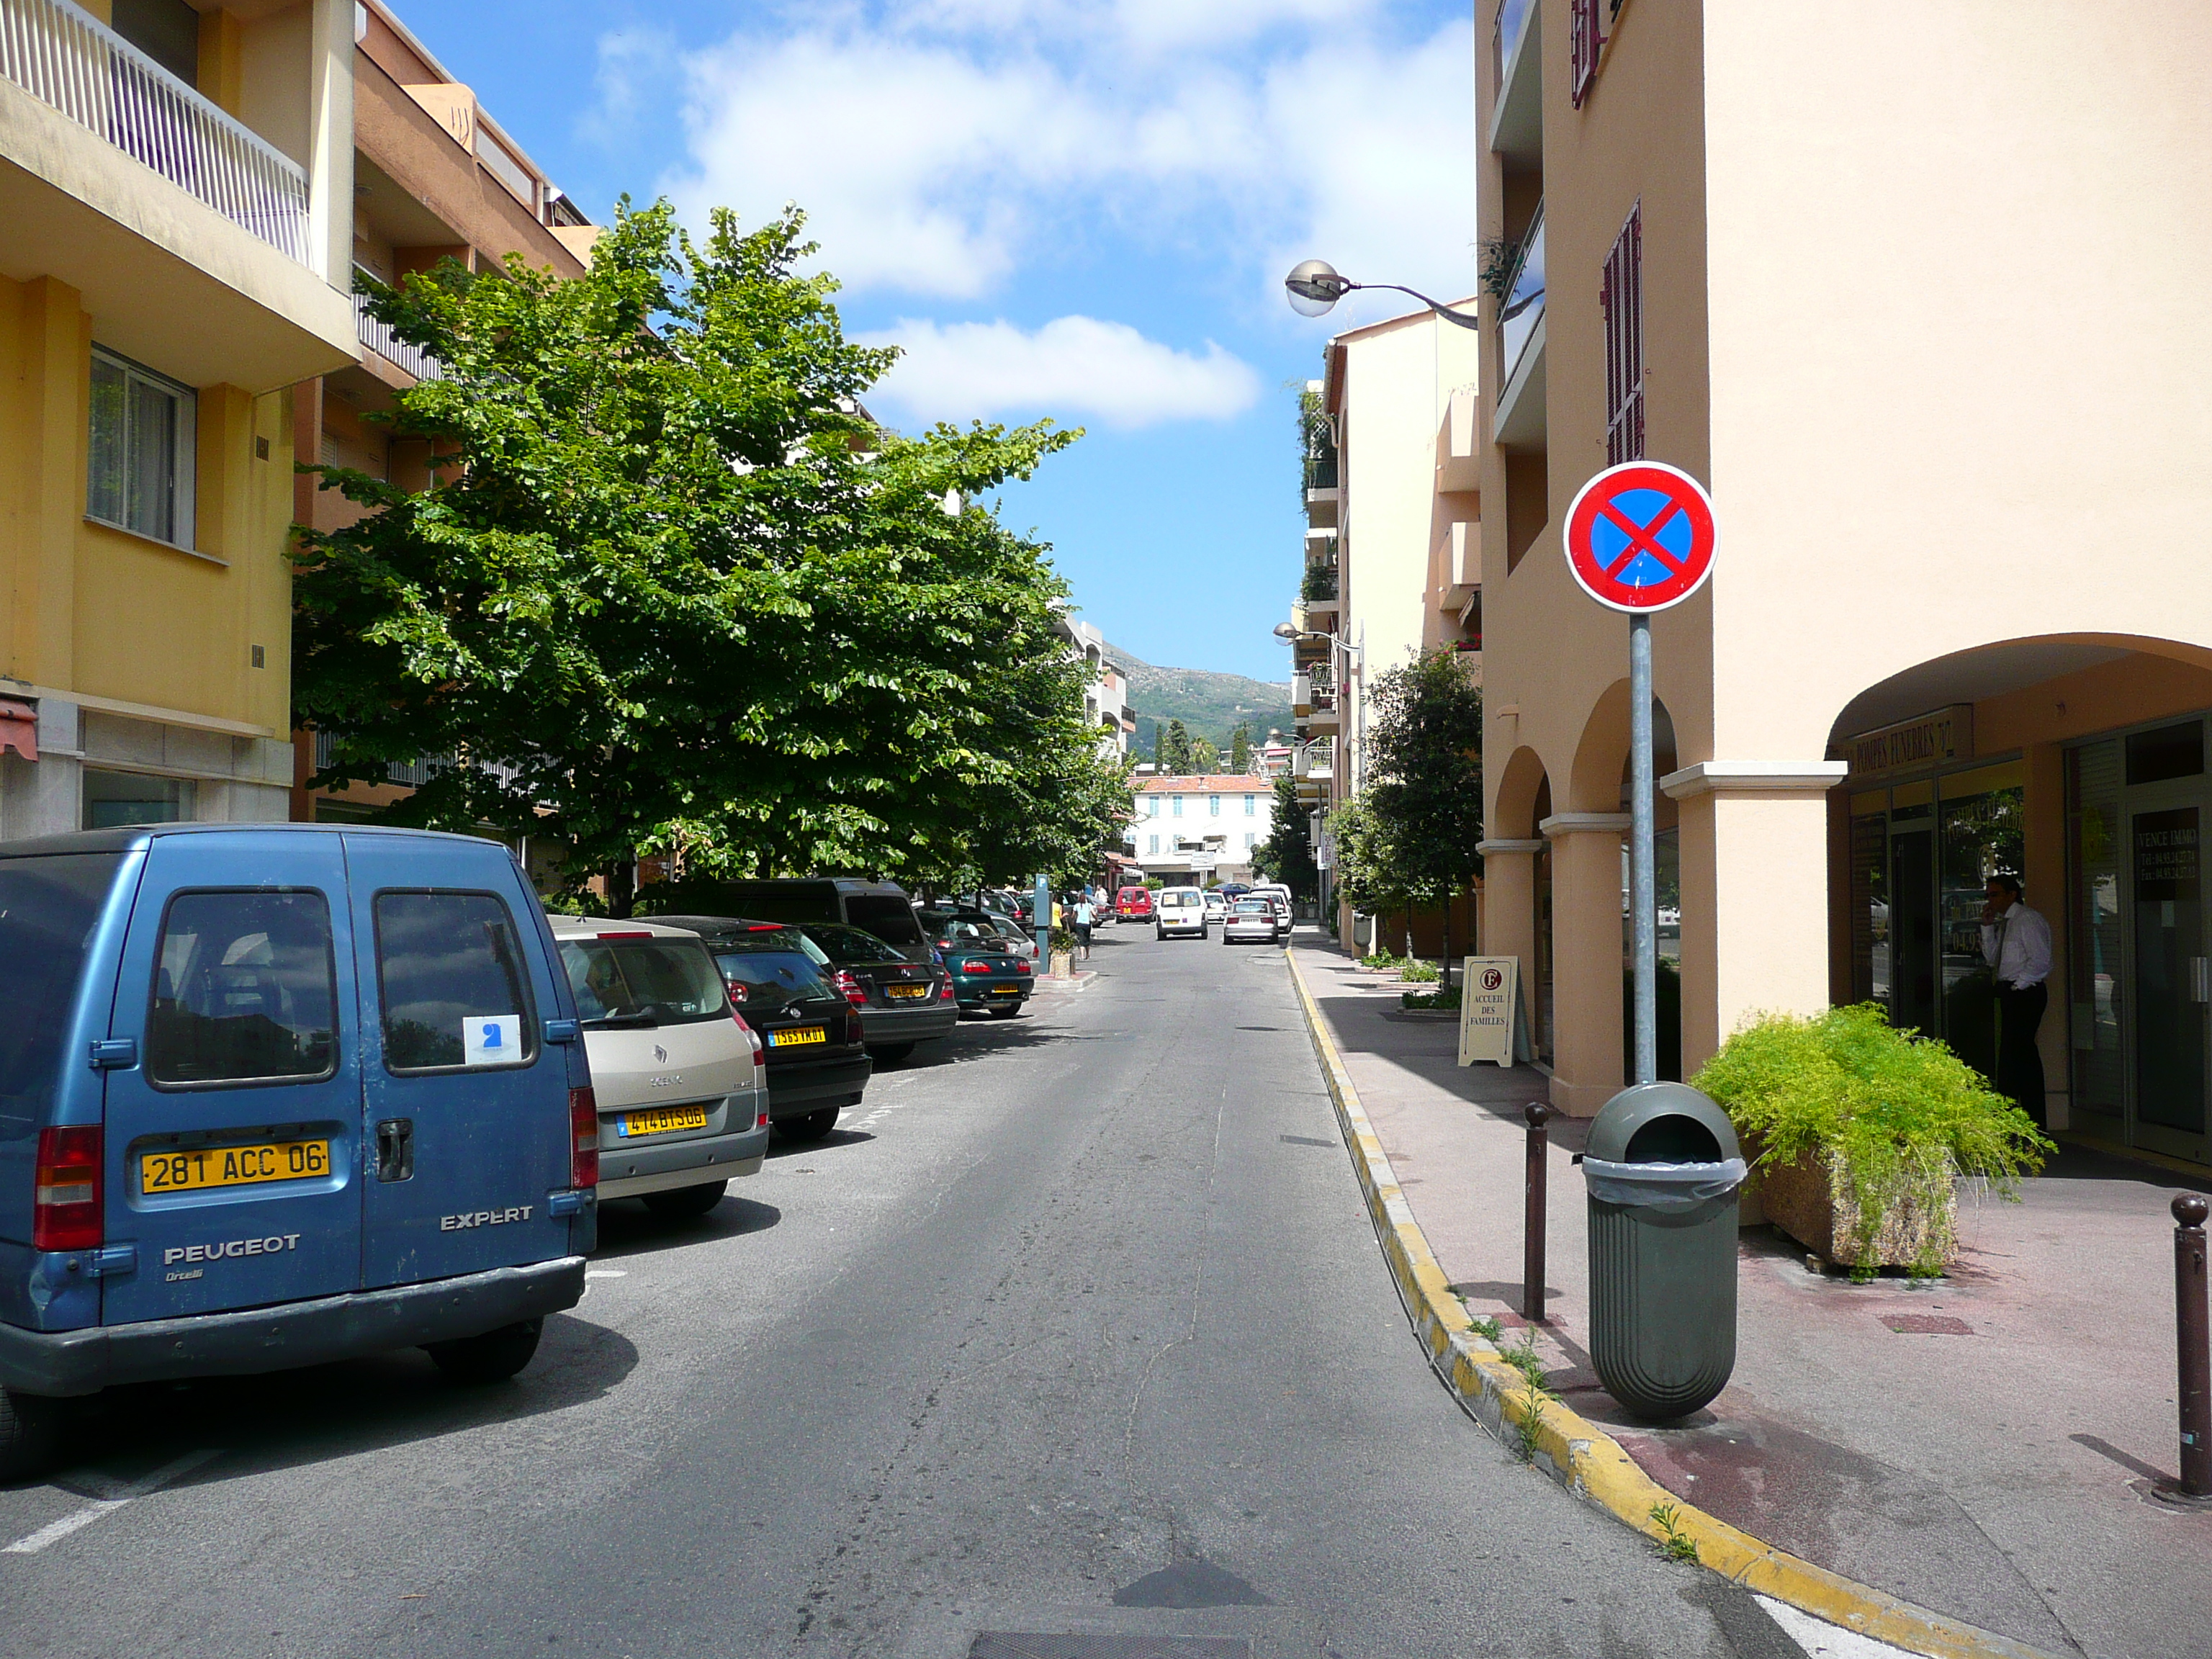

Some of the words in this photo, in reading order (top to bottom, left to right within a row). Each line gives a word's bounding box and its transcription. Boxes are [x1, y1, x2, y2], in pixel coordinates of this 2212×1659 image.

[1857, 735, 1887, 773] POMPES
[1890, 722, 1935, 765] FUNEBRES
[2139, 831, 2168, 848] VENCE
[1474, 994, 1504, 1003] ACCUEIL
[1470, 1017, 1505, 1025] FAMILLES
[1482, 1006, 1496, 1015] DES
[151, 1154, 204, 1187] 281
[223, 1148, 275, 1179] ACC
[289, 1143, 322, 1173] 06
[441, 1205, 534, 1231] EXPERT
[164, 1233, 301, 1265] PEUGEOT
